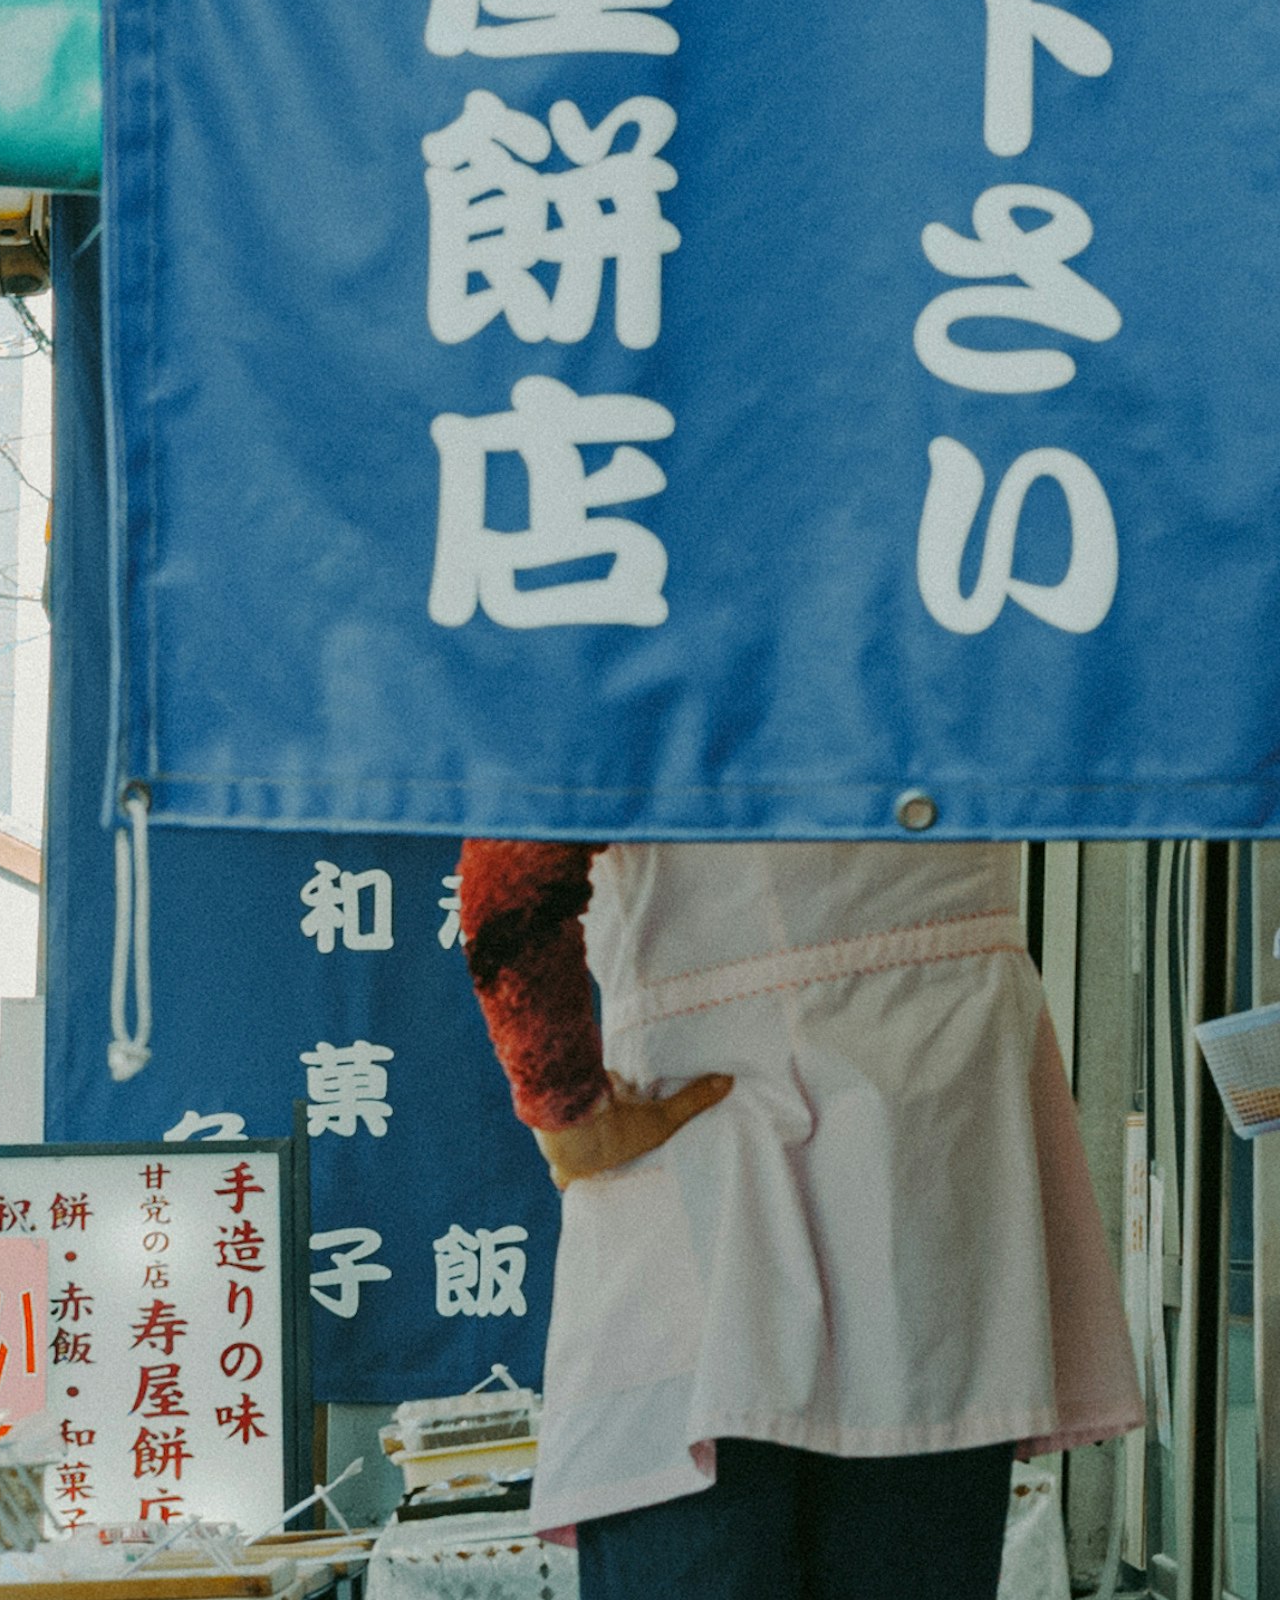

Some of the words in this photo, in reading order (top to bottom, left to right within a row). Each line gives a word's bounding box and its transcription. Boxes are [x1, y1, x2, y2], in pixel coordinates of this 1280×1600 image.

[137, 1162, 172, 1290] 甘党の店
[299, 860, 395, 1318] 和菓子
[213, 1161, 269, 1445] 手造りの味
